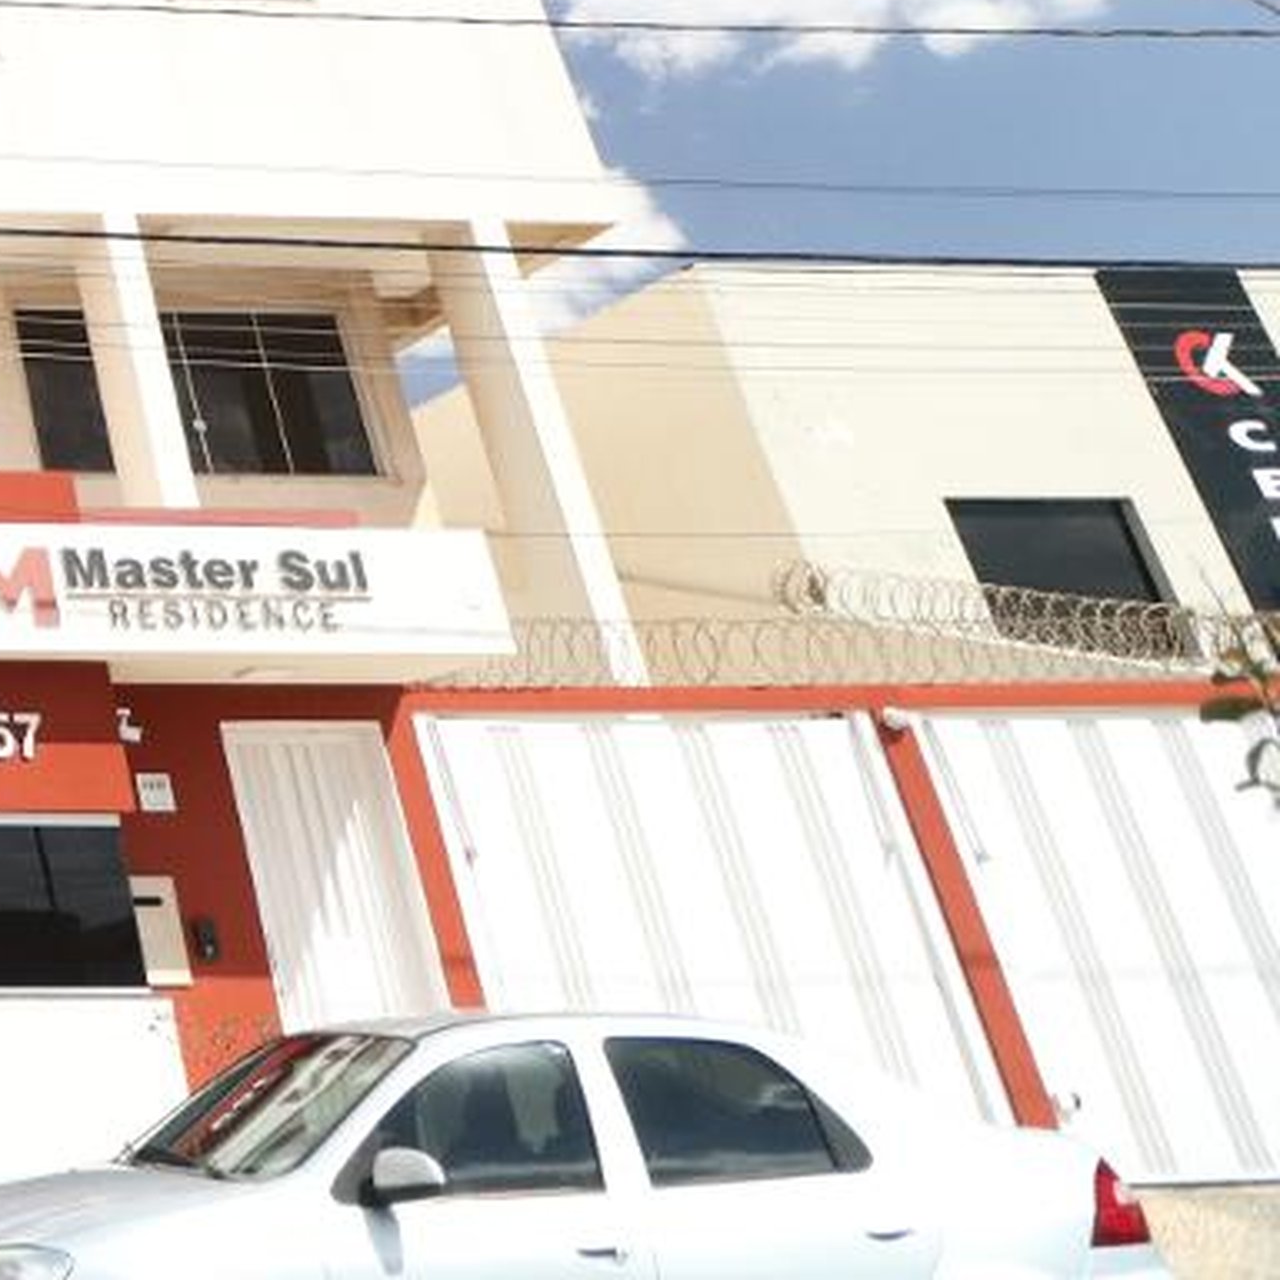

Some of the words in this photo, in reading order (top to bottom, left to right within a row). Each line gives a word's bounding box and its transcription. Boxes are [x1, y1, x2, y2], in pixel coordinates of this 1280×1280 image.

[60, 548, 258, 592] Master
[277, 550, 370, 593] Sul
[107, 599, 344, 632] RESIDENCE
